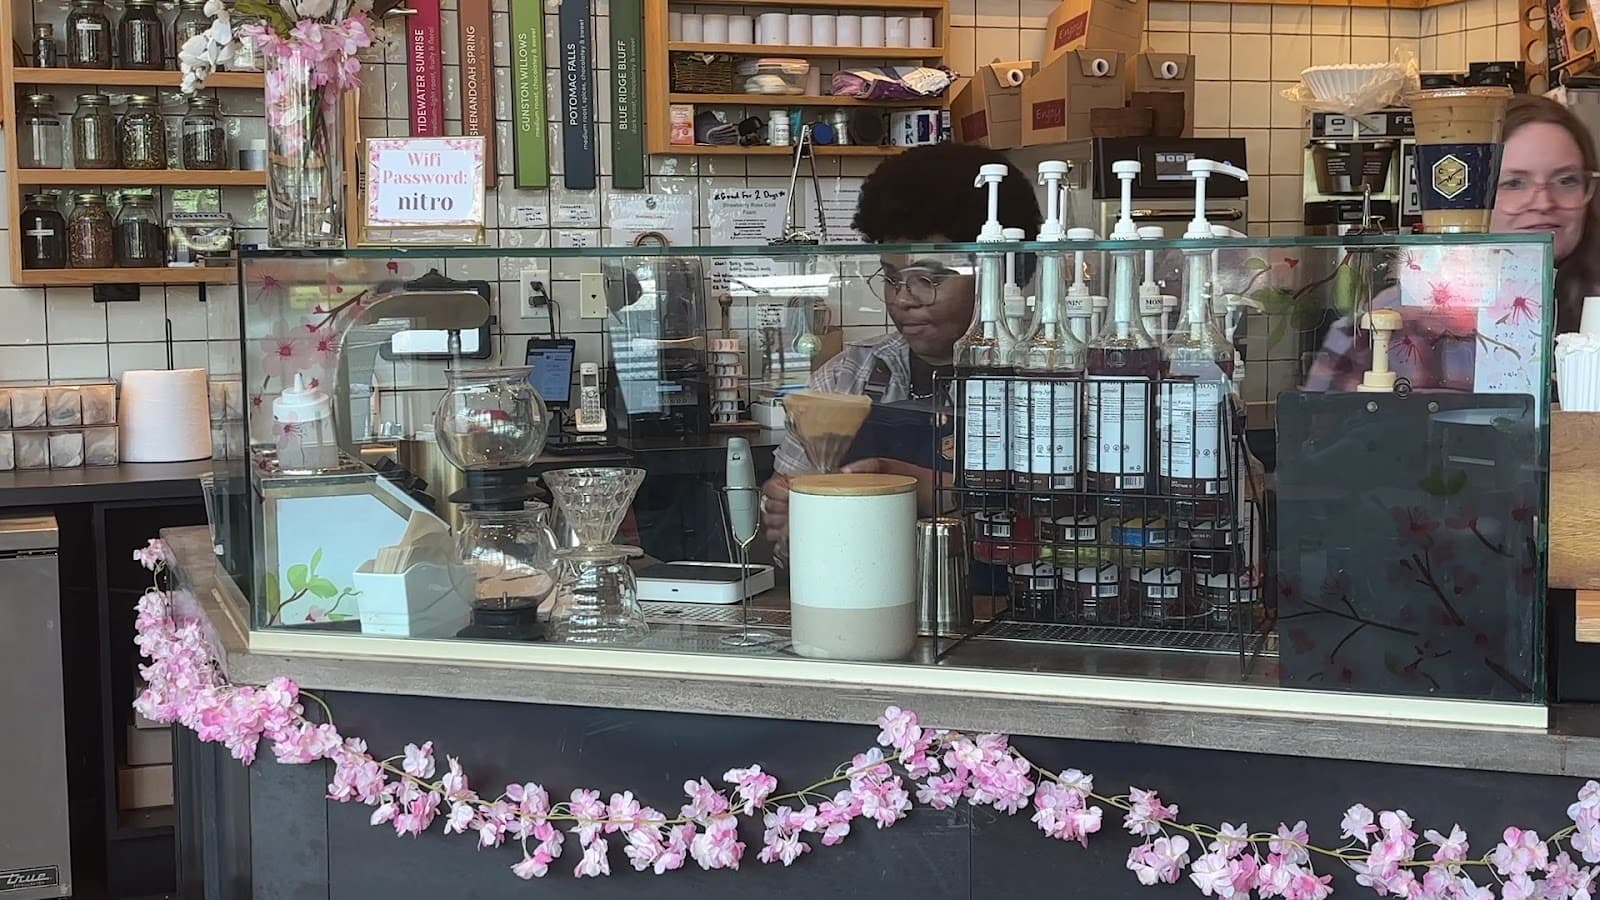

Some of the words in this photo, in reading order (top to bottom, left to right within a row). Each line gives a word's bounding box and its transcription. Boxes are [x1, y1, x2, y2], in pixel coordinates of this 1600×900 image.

[415, 29, 425, 73] SUNRISE
[466, 26, 476, 64] SPRING
[518, 33, 528, 80] WILLOWS
[567, 43, 576, 71] FALLS
[618, 40, 626, 70] BLUFF
[468, 67, 478, 136] SHENANDOAH
[568, 74, 578, 126] POTOMAC
[618, 73, 627, 103] RIDGE
[417, 75, 427, 134] TIDEWATER
[520, 82, 530, 131] GUNSTON
[619, 106, 628, 130] BLUE
[1036, 108, 1061, 124] Enjoy
[408, 152, 440, 167] Wifi
[383, 170, 468, 184] Password:
[398, 192, 454, 211] nitro
[755, 190, 761, 200] 2
